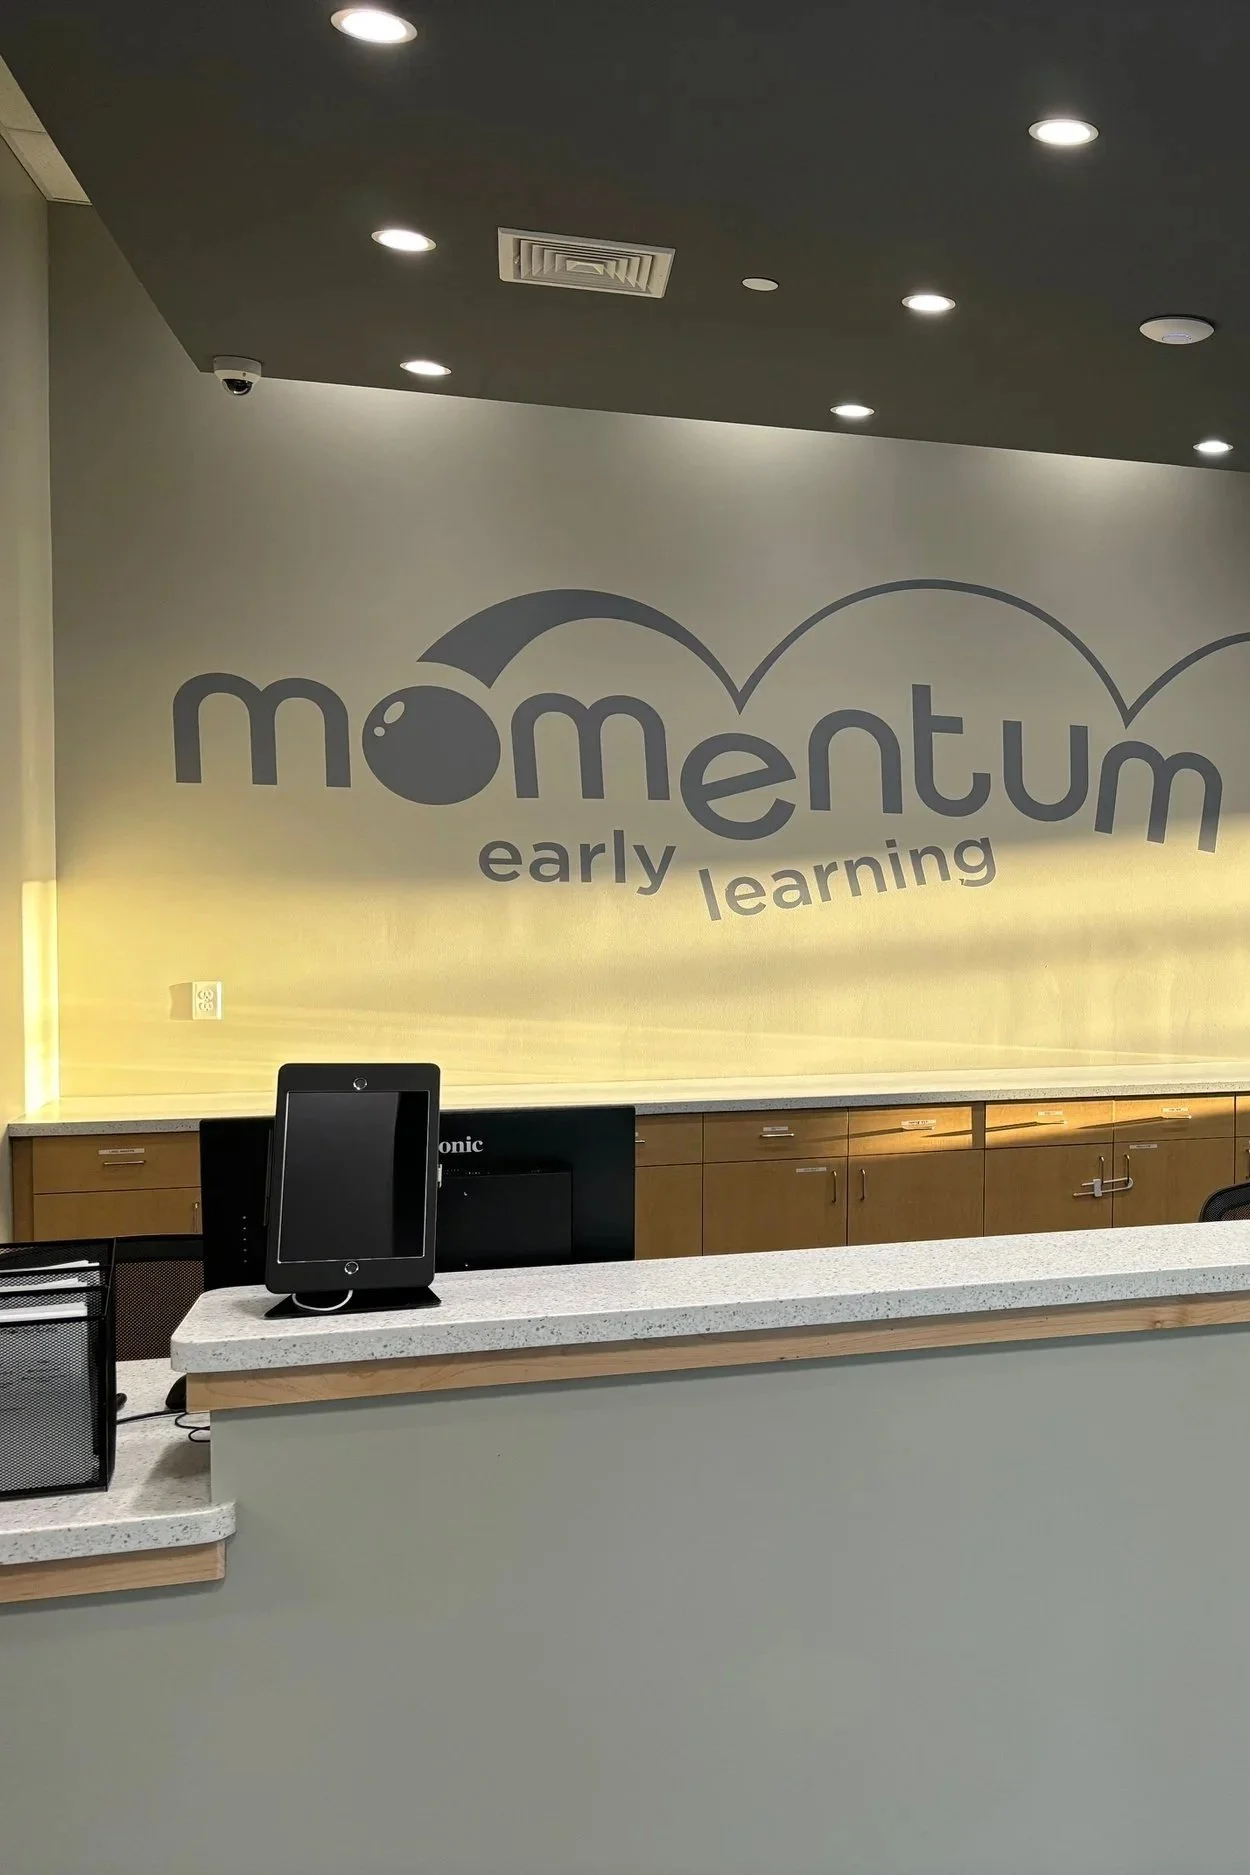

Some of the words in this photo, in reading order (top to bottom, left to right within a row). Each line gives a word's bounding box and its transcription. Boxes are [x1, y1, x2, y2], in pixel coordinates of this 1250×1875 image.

[172, 672, 1223, 854] momentum
[478, 829, 677, 896] early
[698, 836, 997, 922] learning
